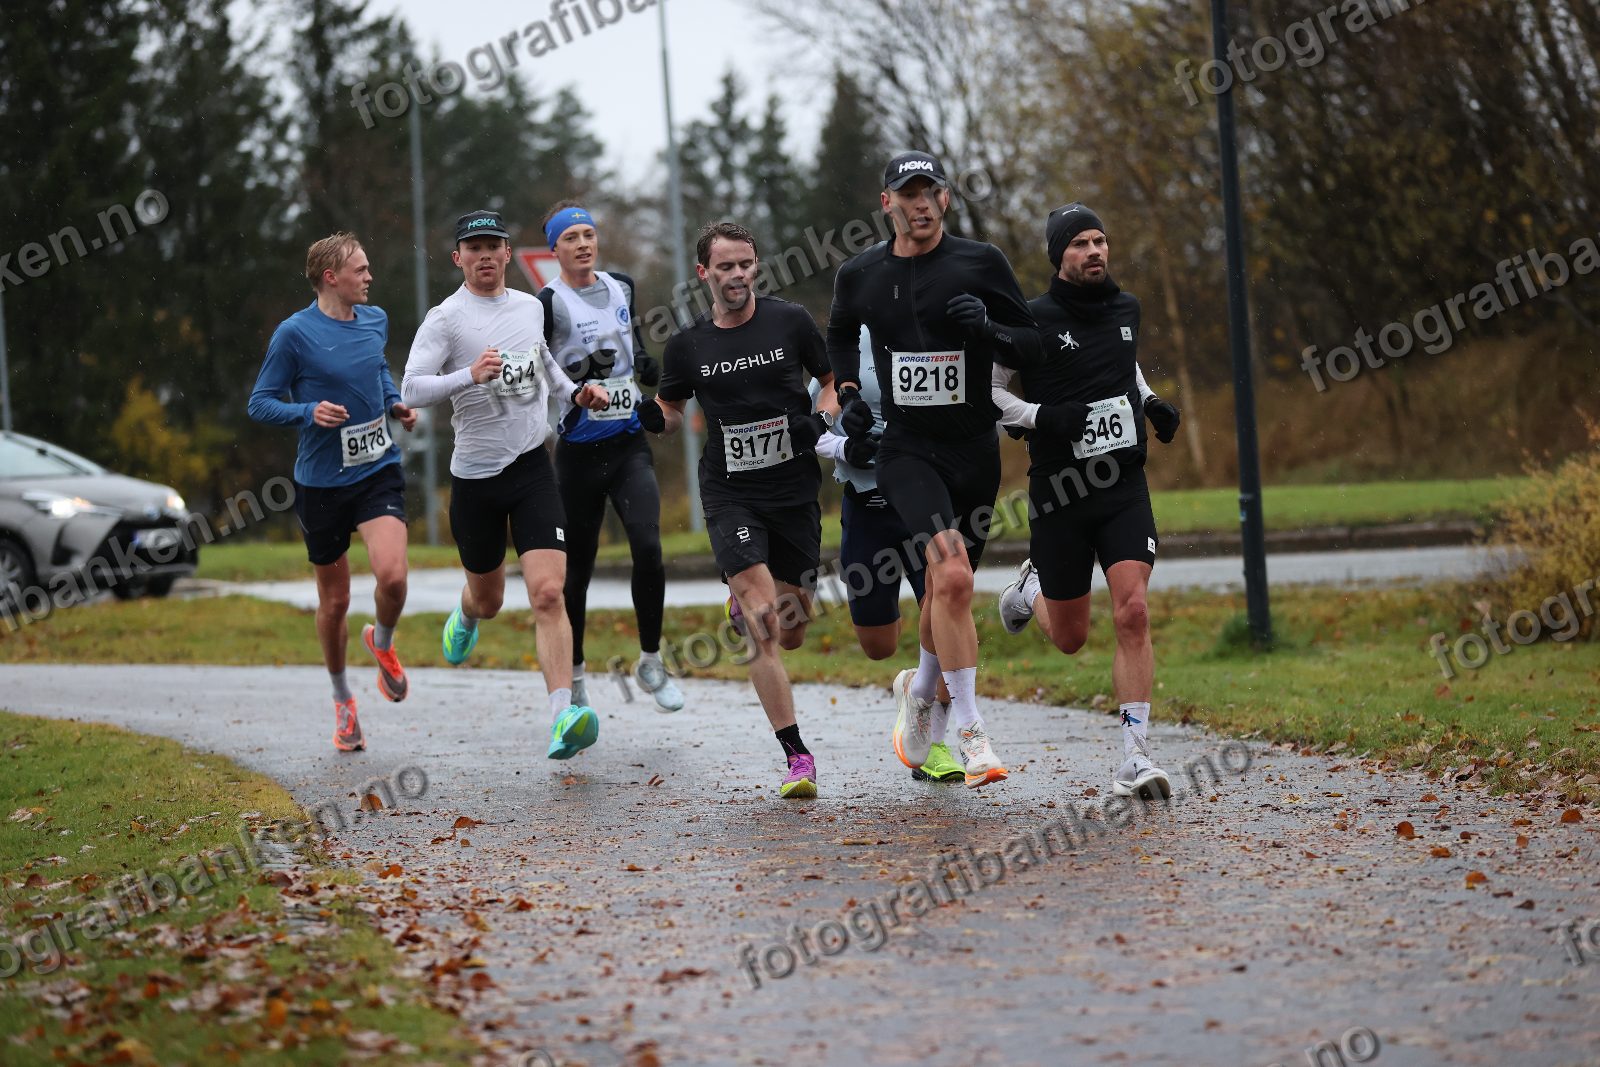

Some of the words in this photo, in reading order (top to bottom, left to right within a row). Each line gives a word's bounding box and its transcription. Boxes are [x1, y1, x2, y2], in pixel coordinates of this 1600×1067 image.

[898, 160, 934, 174] HOKA
[467, 217, 497, 230] HOKA
[898, 355, 960, 363] NORGESTESTEN
[502, 360, 536, 386] 614
[898, 365, 959, 392] 9218
[728, 419, 785, 435] NORGESTESTEN
[1083, 413, 1123, 446] 546
[347, 427, 386, 456] 9478
[730, 428, 785, 460] 9177
